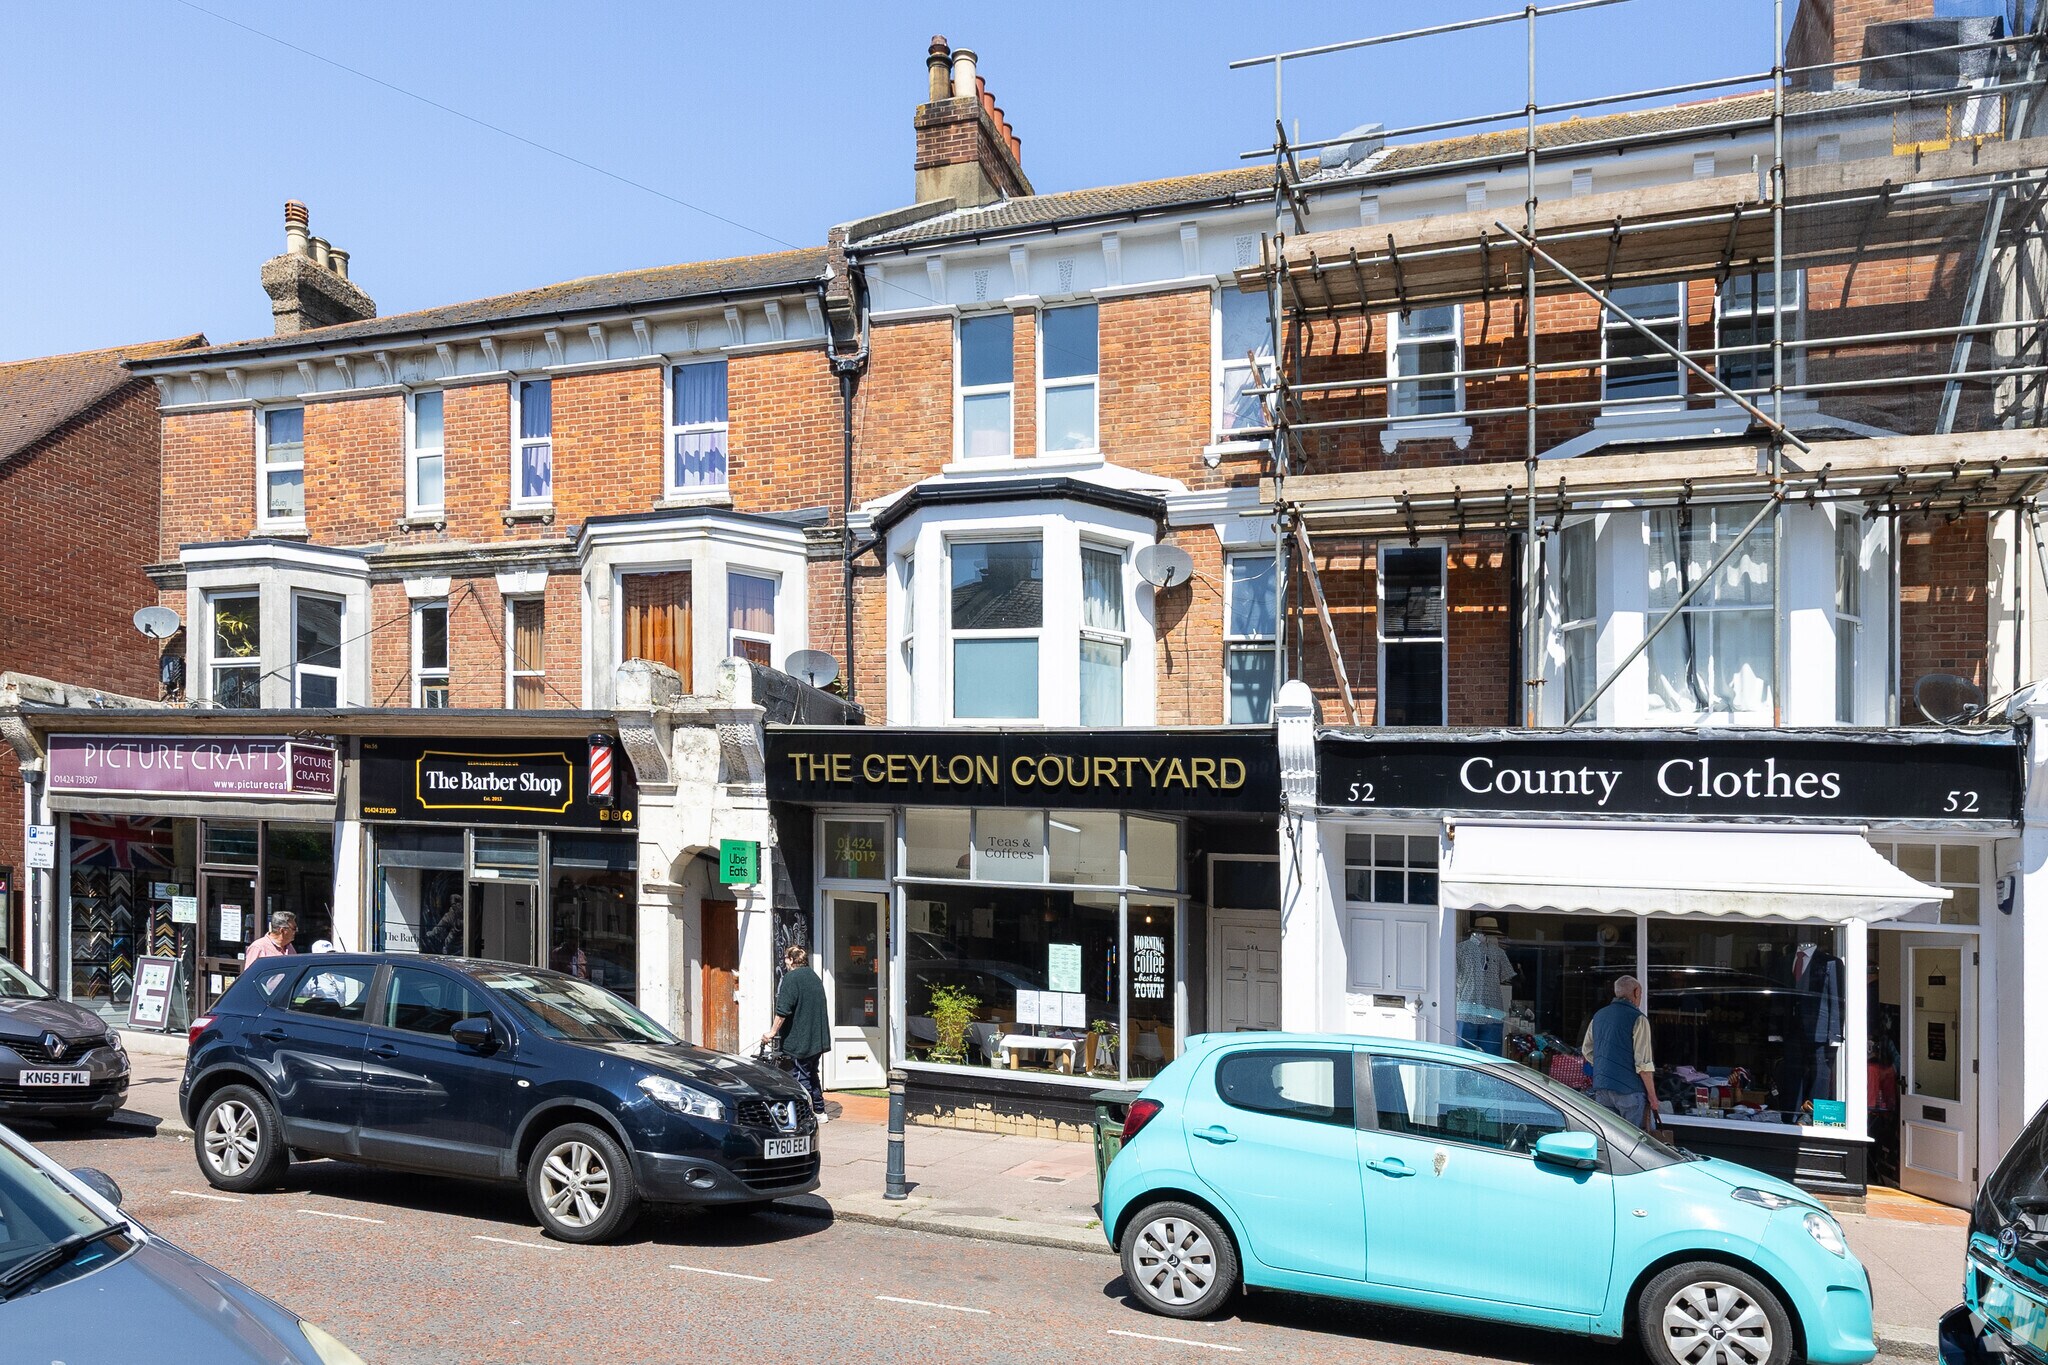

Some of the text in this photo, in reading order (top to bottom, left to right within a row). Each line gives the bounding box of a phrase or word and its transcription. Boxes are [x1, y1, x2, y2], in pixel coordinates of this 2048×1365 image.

[85, 743, 286, 770] PICTURE CRAFTS
[293, 754, 332, 769] PICTURE
[295, 769, 330, 783] CRAFTS
[788, 753, 1247, 789] THE CEYLON COURTYARD
[54, 774, 98, 784] 01424 731307
[213, 780, 288, 791] www.picturecraf
[426, 770, 562, 797] The Barber Shop
[1460, 756, 1841, 806] County Clothes
[1348, 783, 1376, 802] 52
[1943, 791, 1980, 813] 52
[837, 838, 873, 849] 01424
[988, 836, 1031, 848] Teas &
[729, 853, 748, 865] Uber
[834, 850, 876, 862] 730019
[985, 847, 1034, 860] Coffees
[729, 866, 748, 877] Eats
[1134, 935, 1165, 954] MORNING
[1134, 950, 1165, 974] coffee
[1139, 973, 1161, 982] best in
[1134, 982, 1165, 999] TOWN
[26, 1072, 85, 1084] KN69 FWL
[769, 1138, 808, 1156] FY60 EEA
